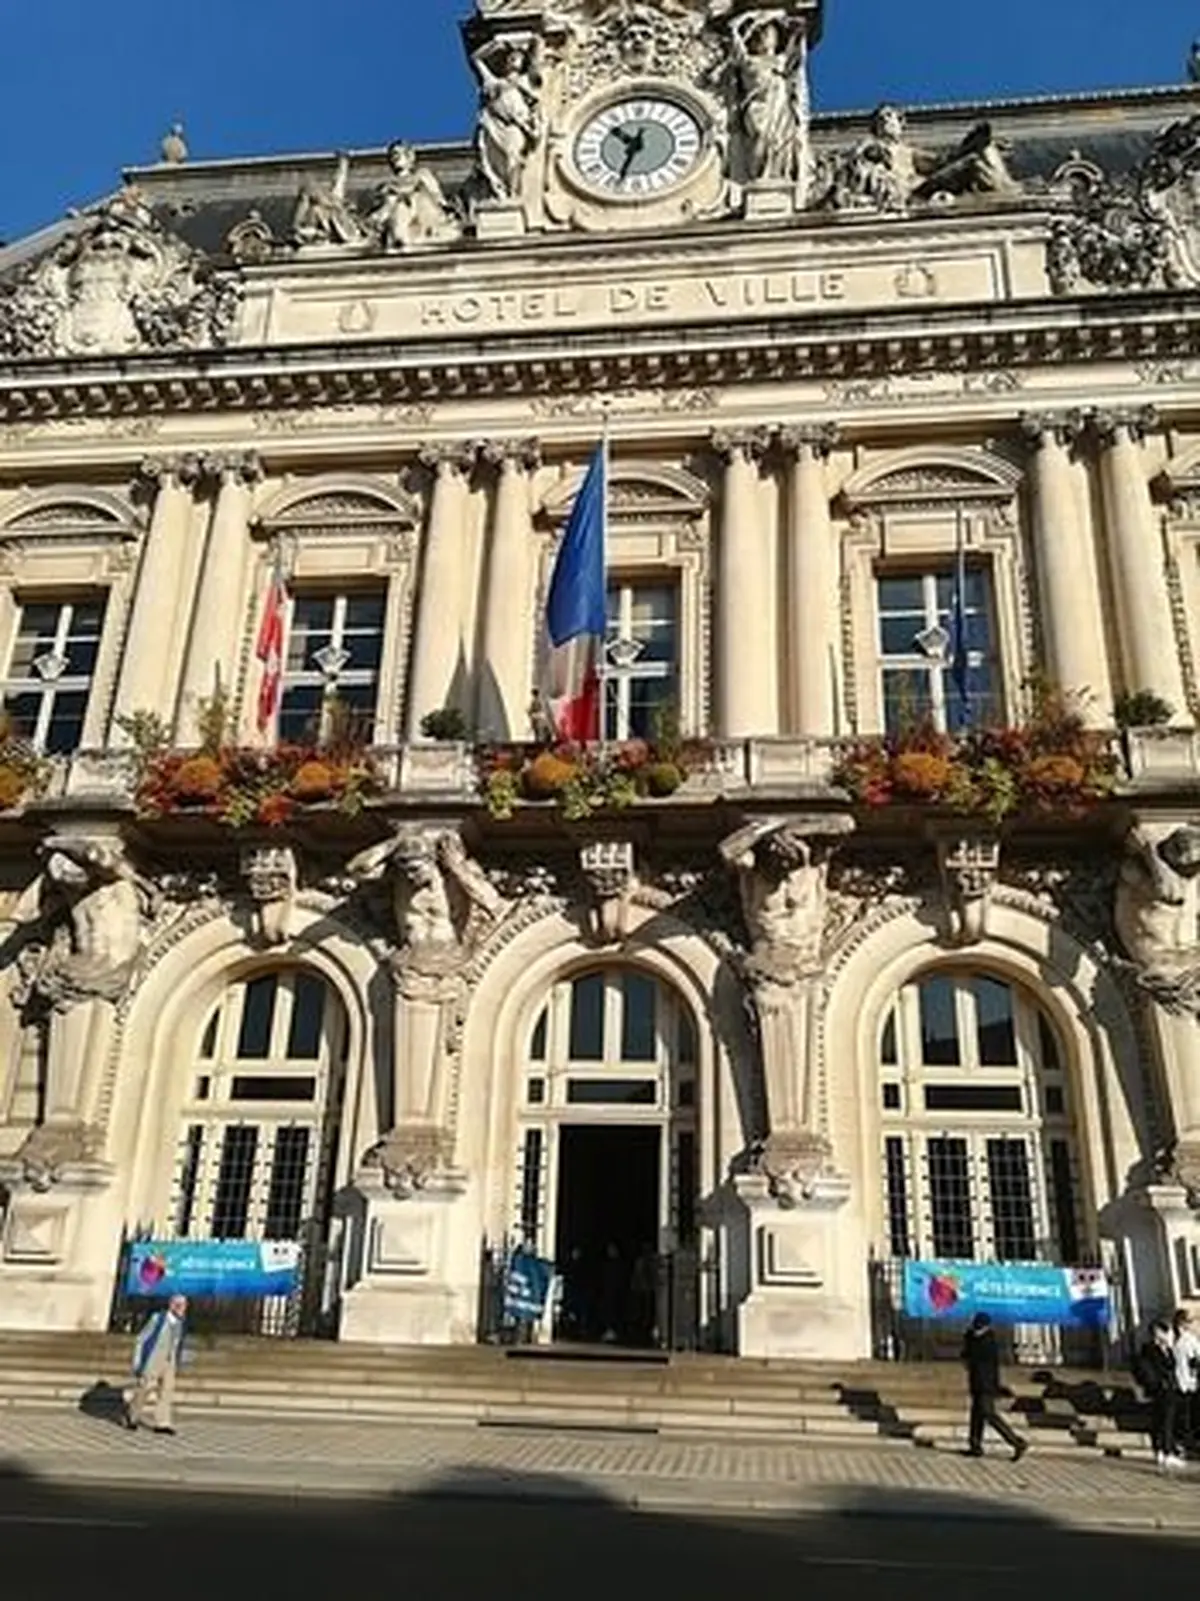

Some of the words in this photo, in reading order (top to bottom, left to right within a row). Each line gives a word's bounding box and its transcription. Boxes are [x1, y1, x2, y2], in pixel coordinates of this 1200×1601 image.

[420, 293, 577, 325] HOTEL
[608, 285, 669, 313] DE
[704, 273, 845, 307] VILLE
